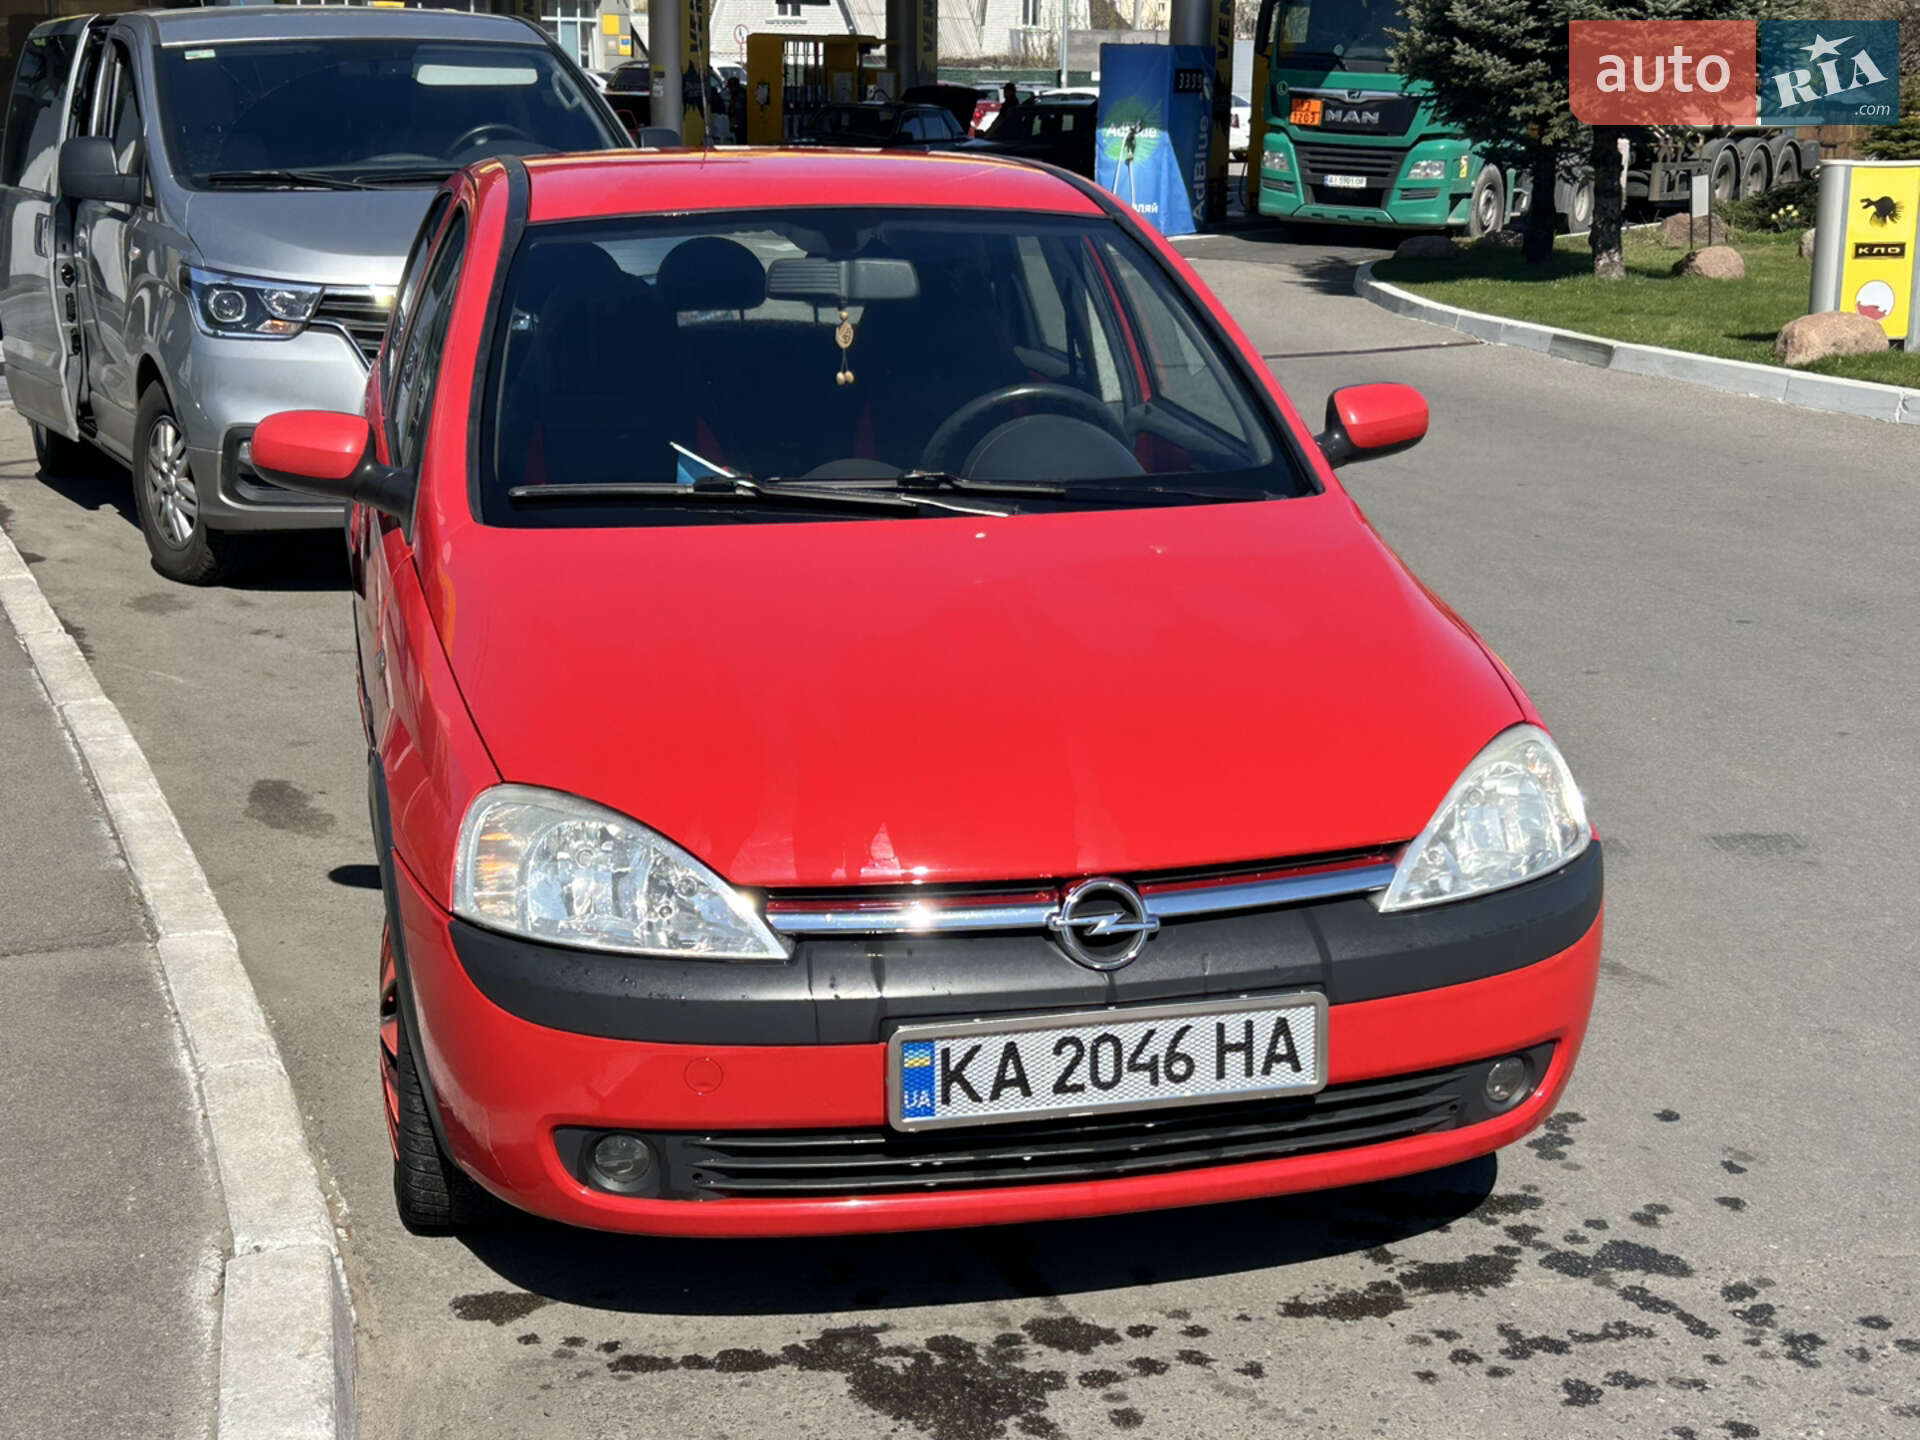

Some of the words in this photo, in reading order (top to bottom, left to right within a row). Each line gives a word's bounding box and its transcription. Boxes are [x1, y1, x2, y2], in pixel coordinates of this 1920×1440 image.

[1325, 109, 1380, 124] MAN
[939, 1041, 1032, 1106] KA
[1052, 1024, 1196, 1095] 2046
[1216, 1016, 1302, 1080] HA
[904, 1088, 931, 1109] UA
